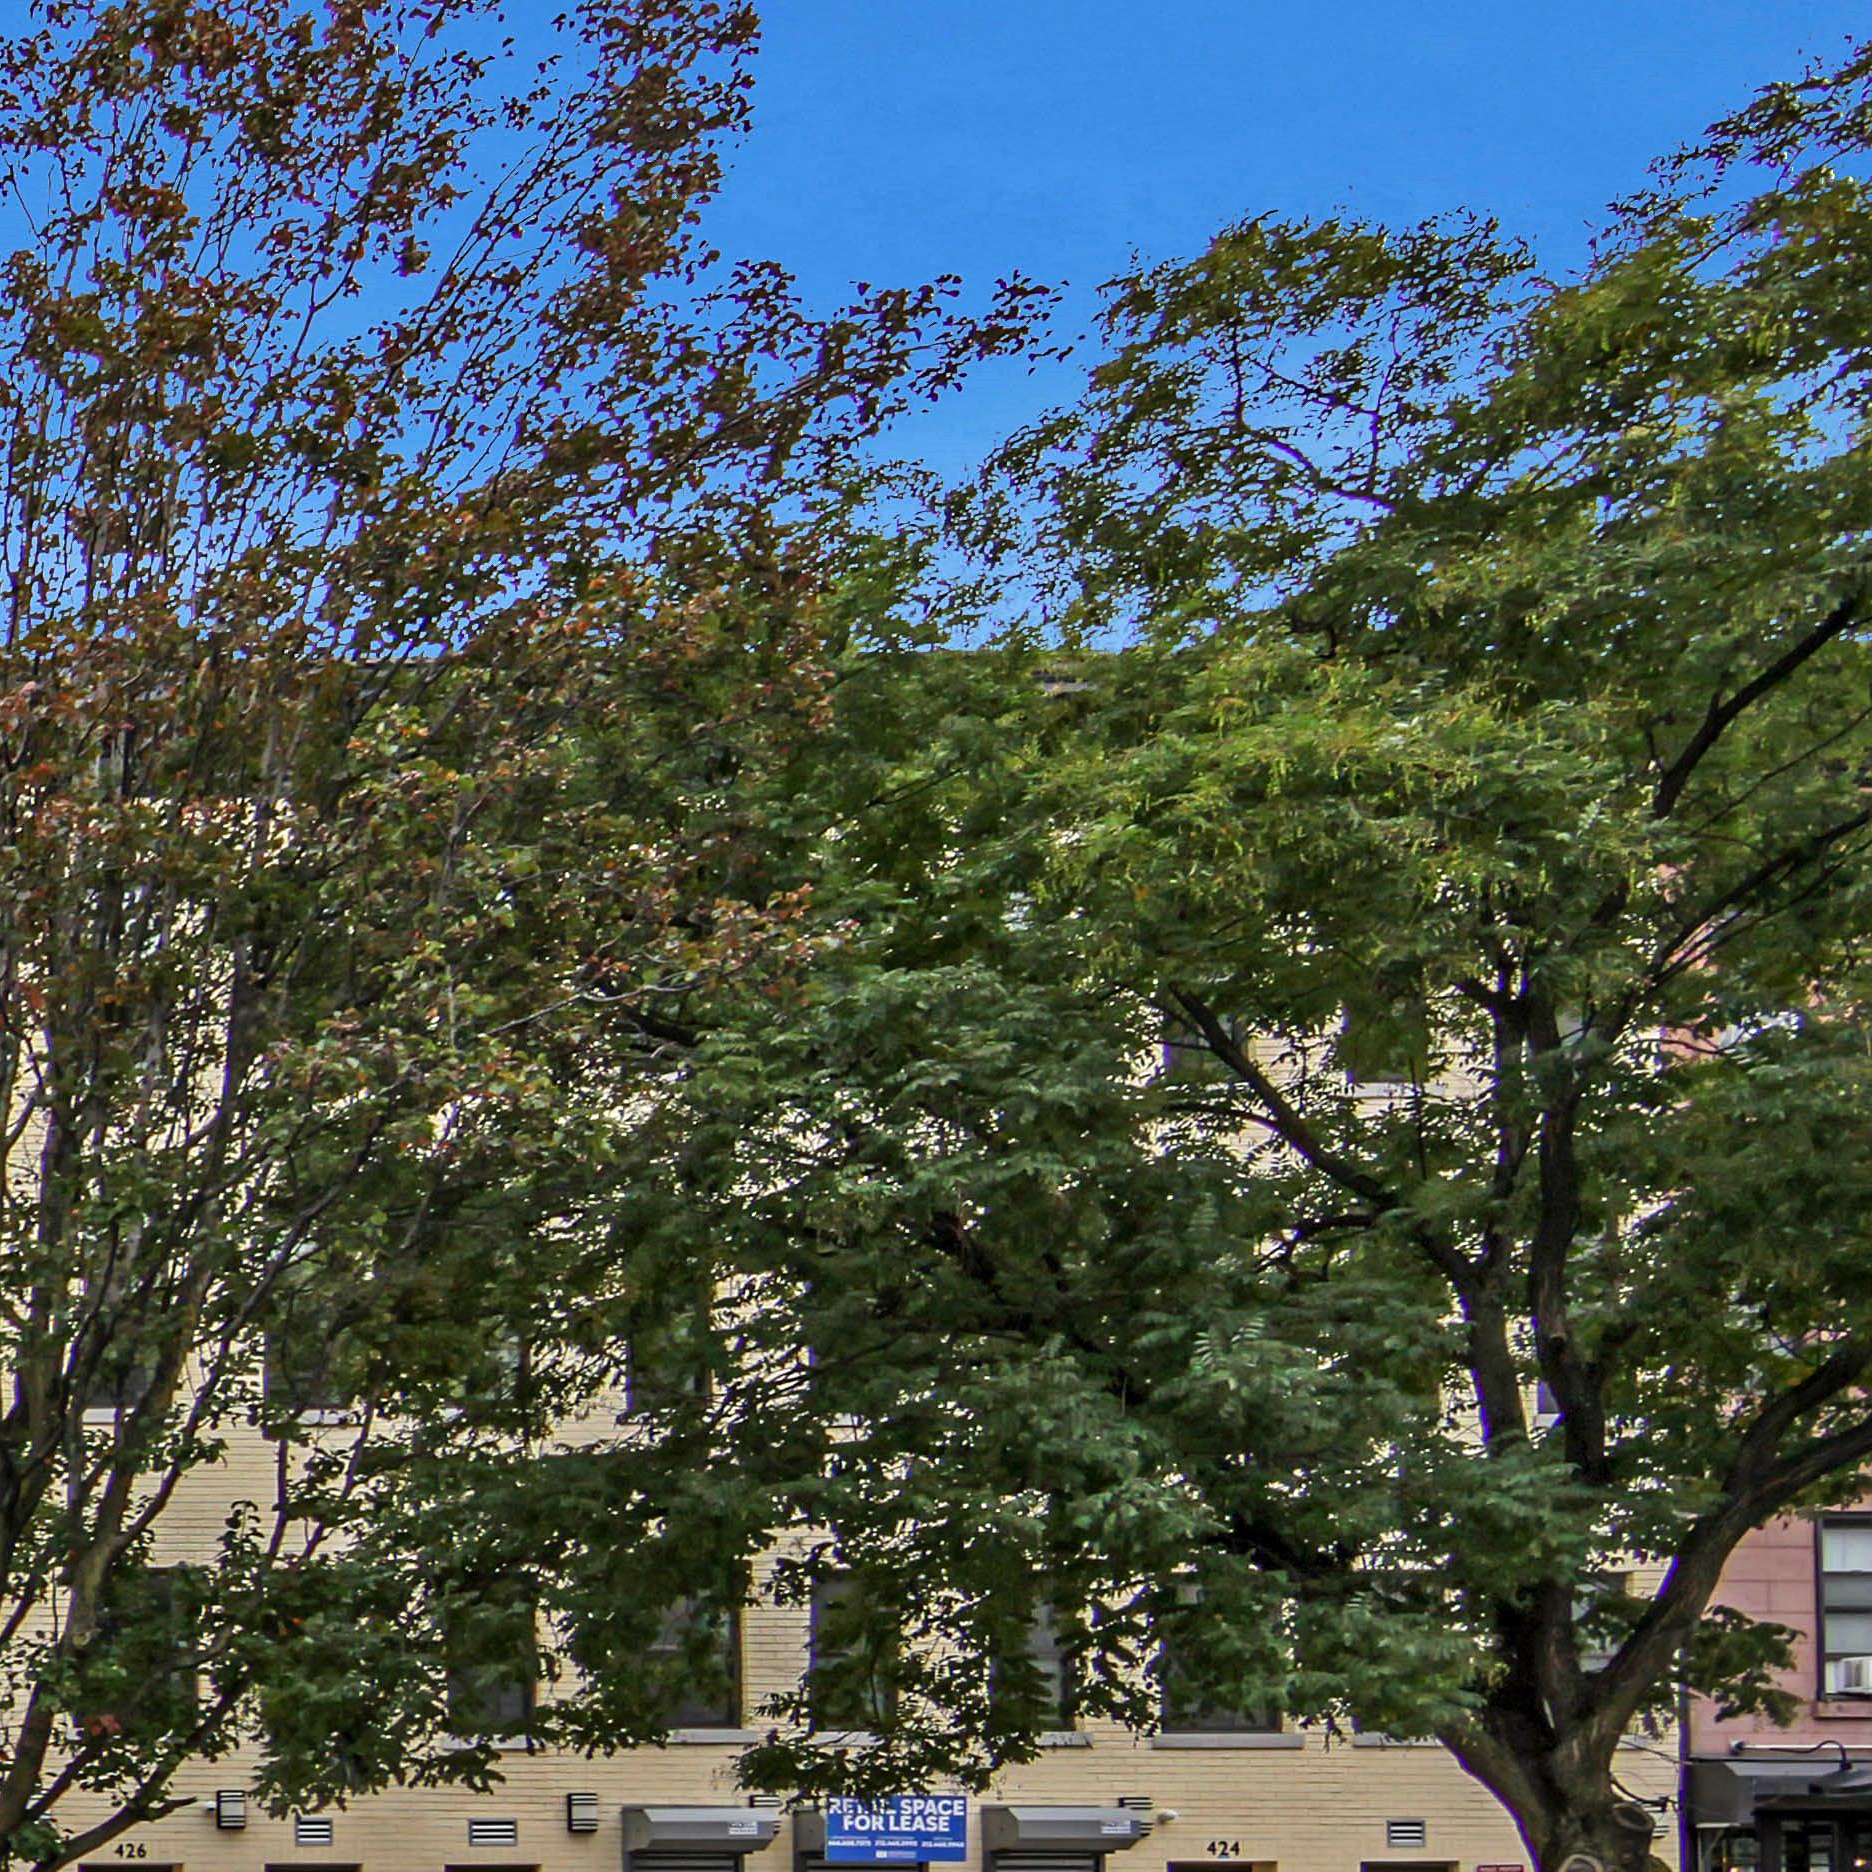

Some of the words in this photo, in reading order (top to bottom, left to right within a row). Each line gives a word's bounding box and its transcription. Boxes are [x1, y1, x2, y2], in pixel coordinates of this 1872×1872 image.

[900, 1799, 965, 1816] SPACE
[843, 1815, 885, 1832] FOR
[888, 1815, 950, 1832] LEASE
[113, 1843, 147, 1858] 426
[1206, 1840, 1240, 1857] 424
